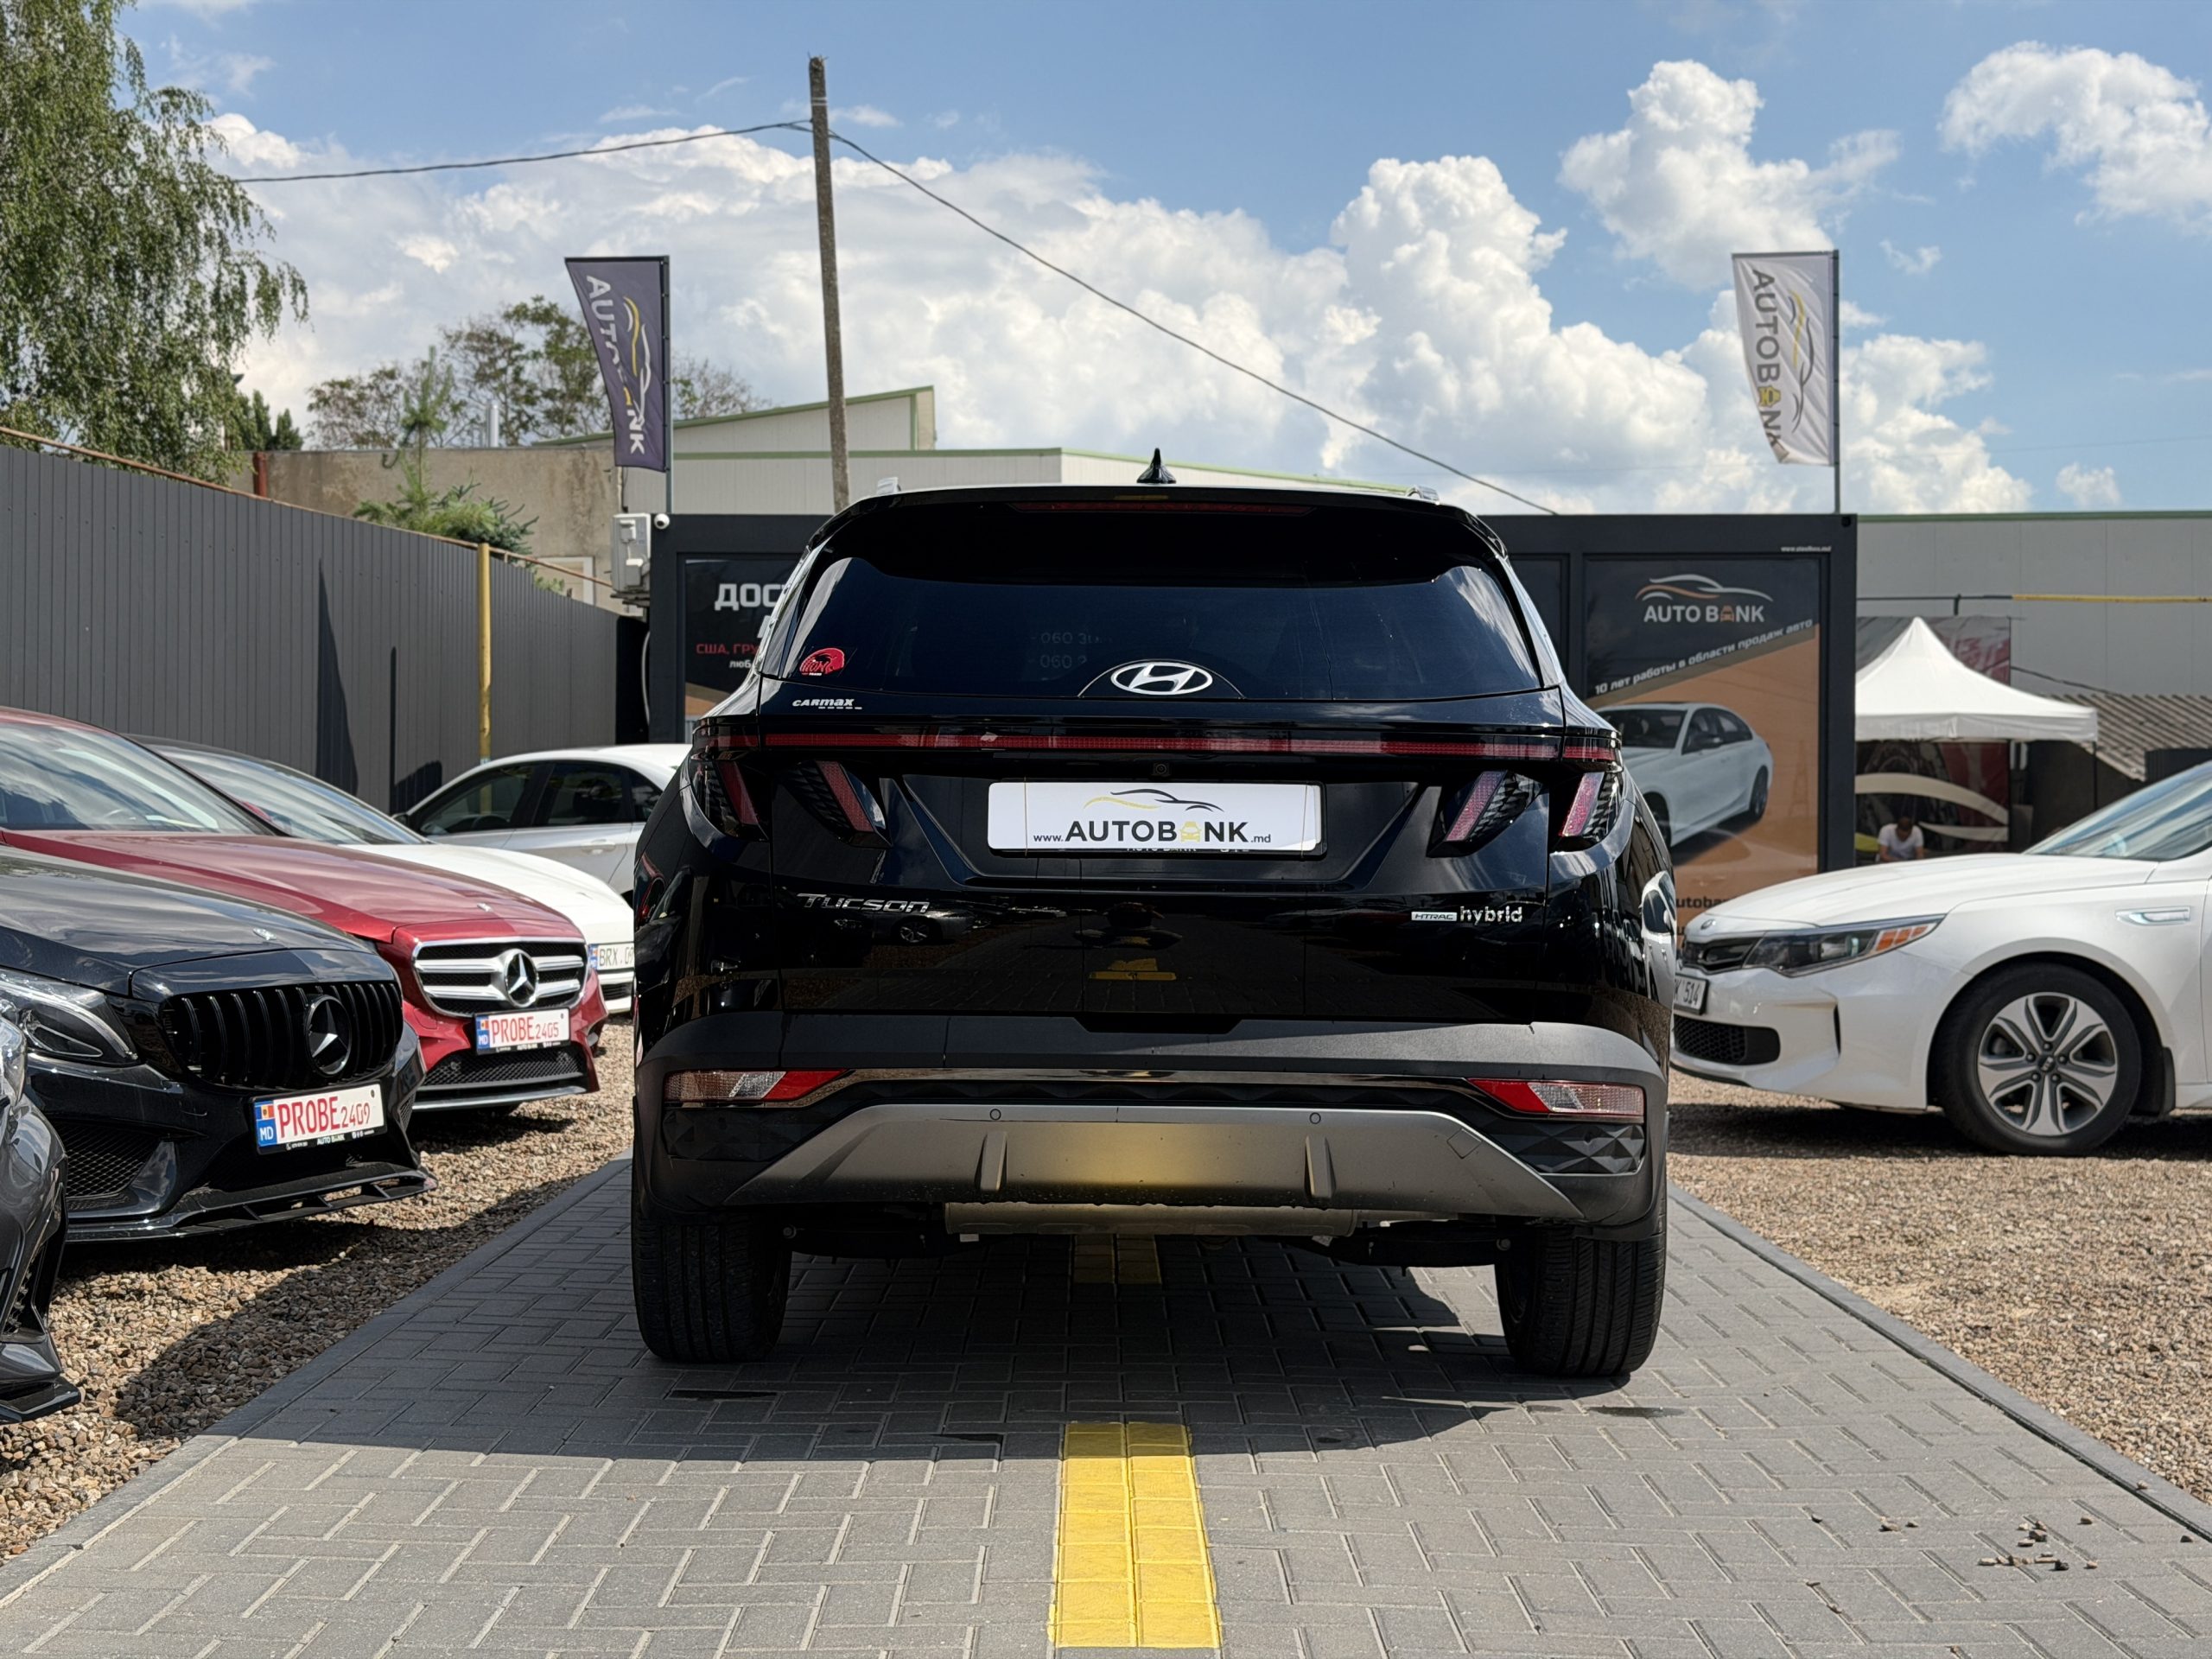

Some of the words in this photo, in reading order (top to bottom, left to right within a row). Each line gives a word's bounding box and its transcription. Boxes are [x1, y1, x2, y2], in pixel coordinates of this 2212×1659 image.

[586, 275, 645, 455] AUTONK
[714, 582, 787, 611] ДОС
[1643, 605, 1701, 623] AUTO
[1595, 683, 1608, 696] 10
[1610, 677, 1630, 690] лет
[1632, 664, 1676, 685] работы
[1678, 658, 1687, 669] в
[1688, 643, 1736, 666] области
[1737, 628, 1784, 651] продаж
[1785, 620, 1813, 634] авто
[1459, 906, 1523, 926] hybrid
[599, 947, 619, 967] BRX
[478, 1034, 489, 1046] MD
[491, 1016, 535, 1045] PROBE
[536, 1021, 559, 1039] 2405
[259, 1126, 275, 1141] MD
[276, 1096, 340, 1139] PROBE
[316, 1136, 331, 1146] AUTO
